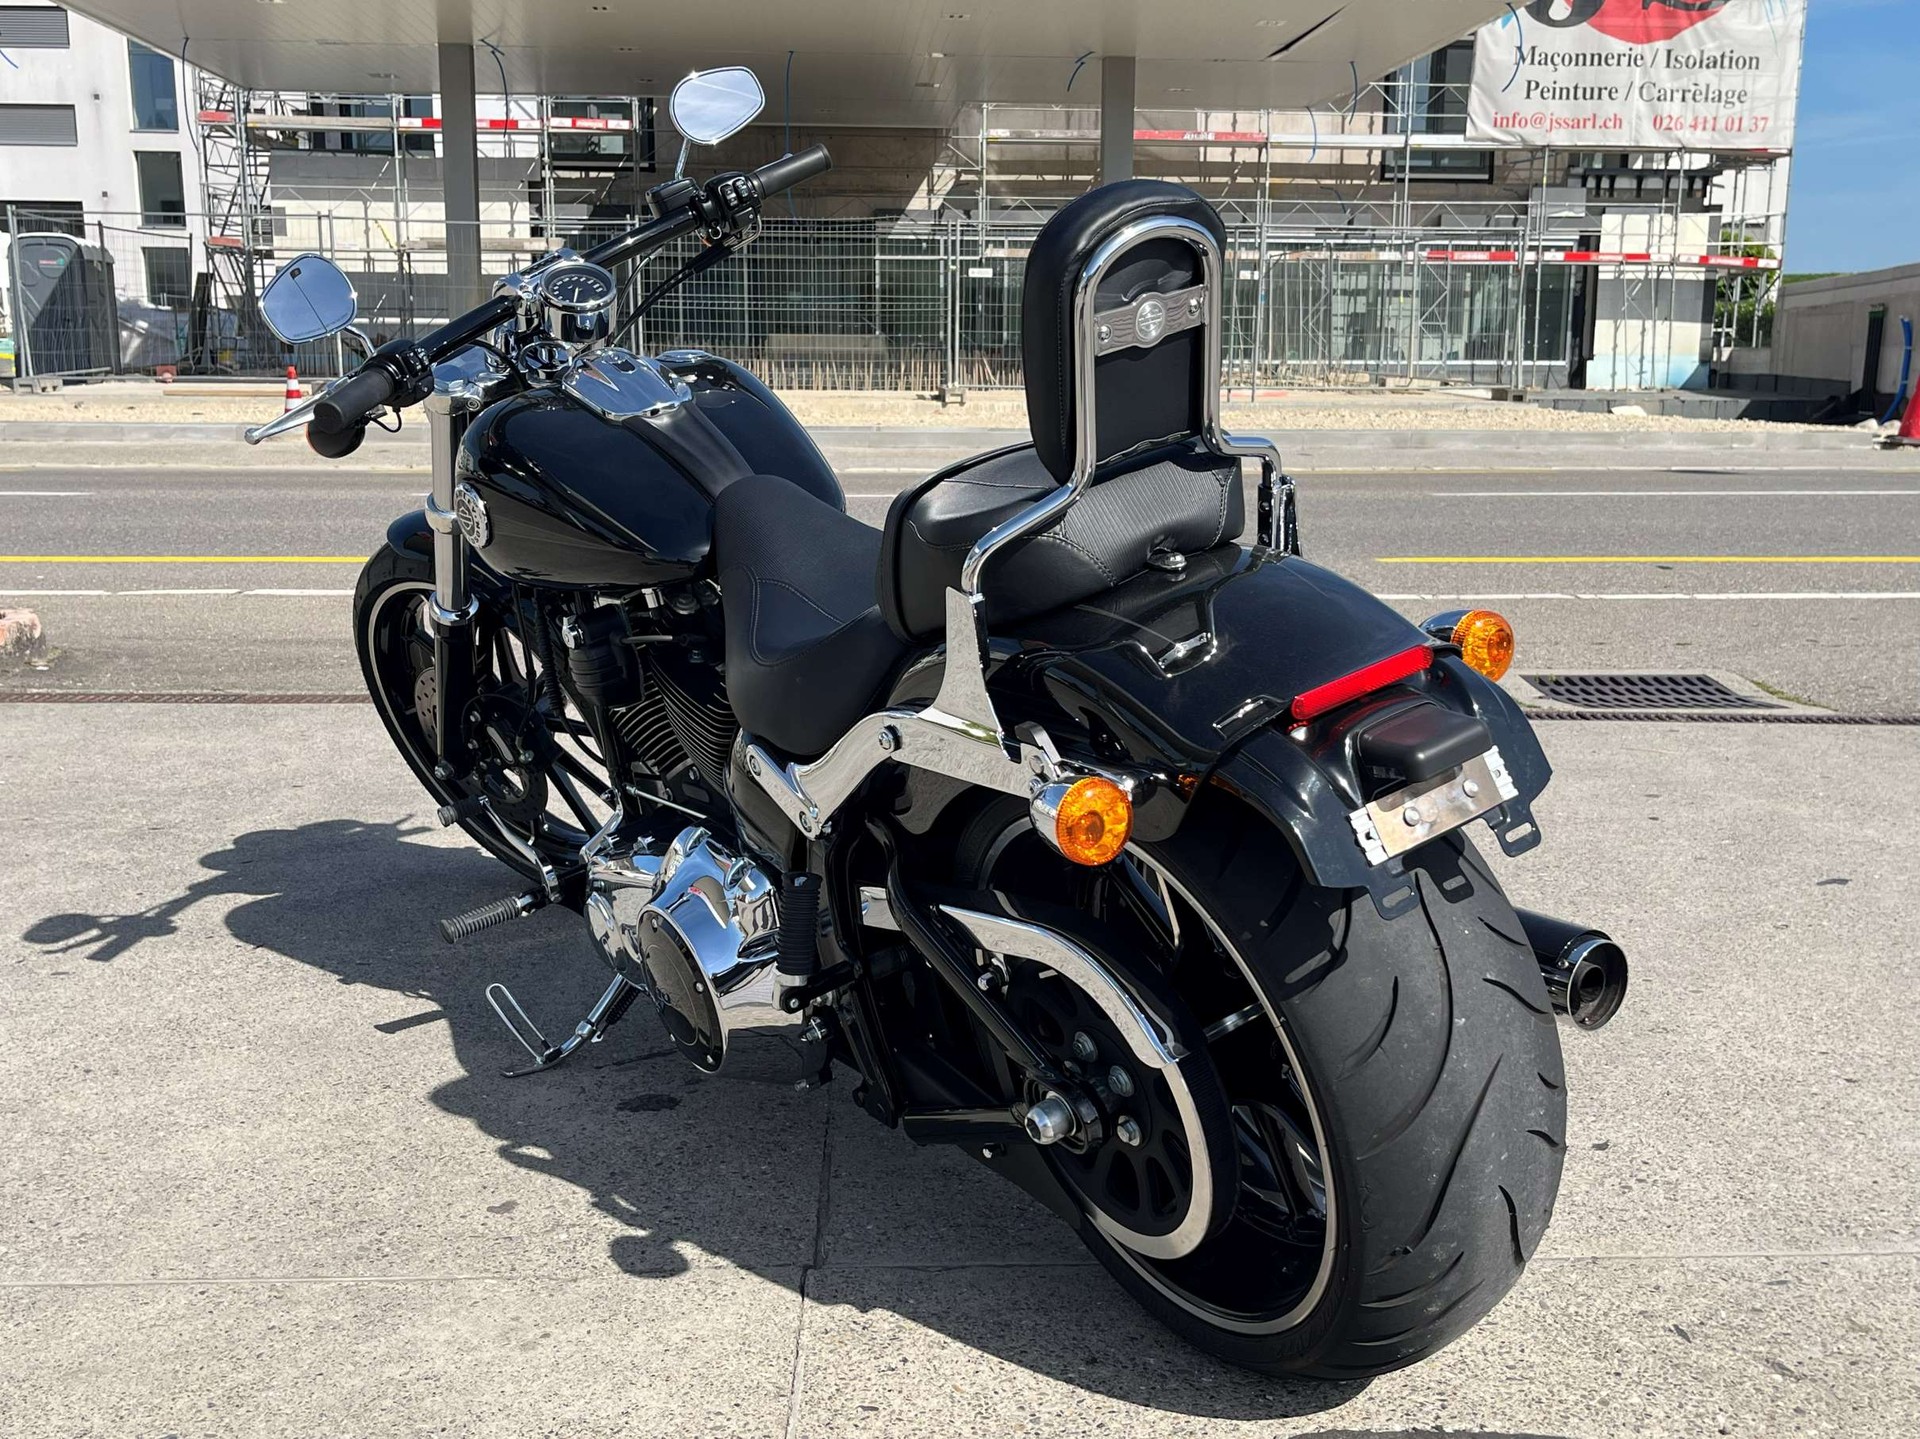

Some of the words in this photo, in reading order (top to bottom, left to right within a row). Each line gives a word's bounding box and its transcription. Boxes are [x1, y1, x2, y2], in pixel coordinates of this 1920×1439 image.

[1513, 45, 1644, 72] Maçonnerie
[1650, 48, 1659, 69] /
[1664, 48, 1760, 70] Isolation
[1524, 79, 1619, 101] Peinture
[1624, 80, 1634, 102] /
[1638, 81, 1748, 109] Carrèlage
[1492, 111, 1623, 132] info@jssarl.ch
[1652, 114, 1684, 131] 026
[1688, 115, 1718, 131] 411
[1725, 116, 1743, 132] 01
[1748, 116, 1770, 133] 37
